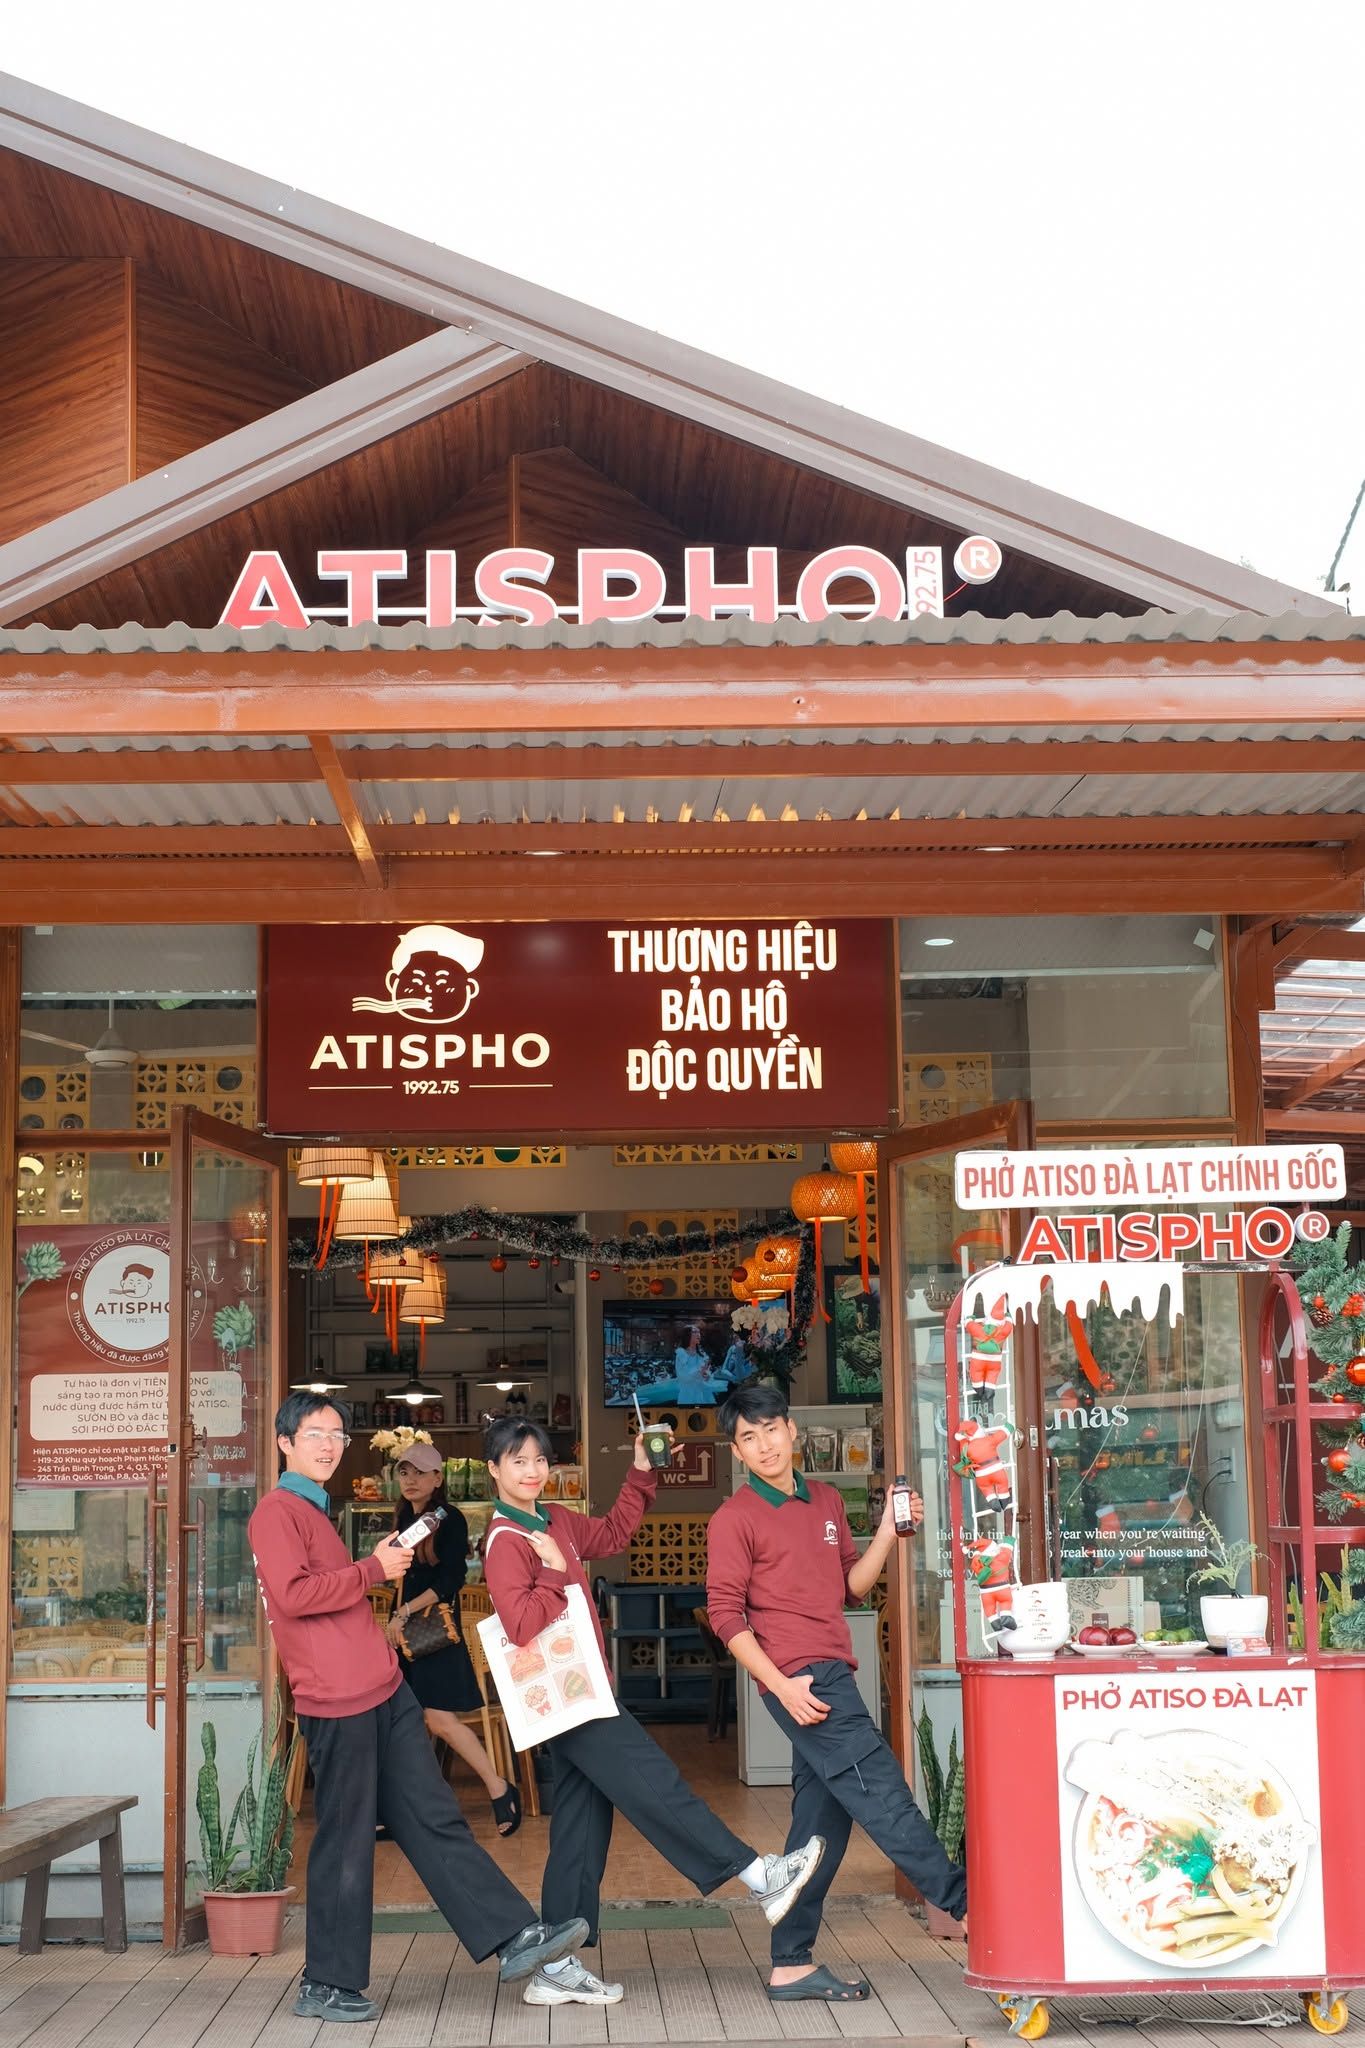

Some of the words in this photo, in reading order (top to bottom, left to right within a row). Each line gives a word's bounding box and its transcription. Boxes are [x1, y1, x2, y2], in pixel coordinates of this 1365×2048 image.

[219, 546, 905, 628] ATISPHO
[608, 927, 748, 973] THƯƠNG
[759, 921, 838, 979] HIỆU
[661, 976, 731, 1032] BẢO
[741, 980, 788, 1040] HỘ
[309, 1033, 551, 1070] ATISPHO
[626, 1040, 697, 1100] ĐỘC
[706, 1034, 823, 1093] QUYỀN
[402, 1079, 460, 1096] 1992.75
[964, 1157, 1014, 1199] PHỞ
[1023, 1163, 1097, 1197] ATISO
[1104, 1156, 1139, 1195] ĐÀ
[1147, 1161, 1193, 1200] LẠT
[1201, 1153, 1280, 1193] CHÍNH
[1288, 1148, 1338, 1190] GỐC
[1016, 1206, 1295, 1264] ATISPHO
[662, 1473, 688, 1484] WC
[1085, 1528, 1116, 1539] when
[1161, 1528, 1206, 1542] waiting
[1119, 1549, 1145, 1561] your
[1149, 1546, 1183, 1558] house
[1187, 1546, 1208, 1558] and
[1063, 1682, 1122, 1710] PHỞ
[1129, 1687, 1207, 1709] ATISO
[1212, 1682, 1253, 1708] ĐÀ
[1258, 1686, 1309, 1711] LẠT
